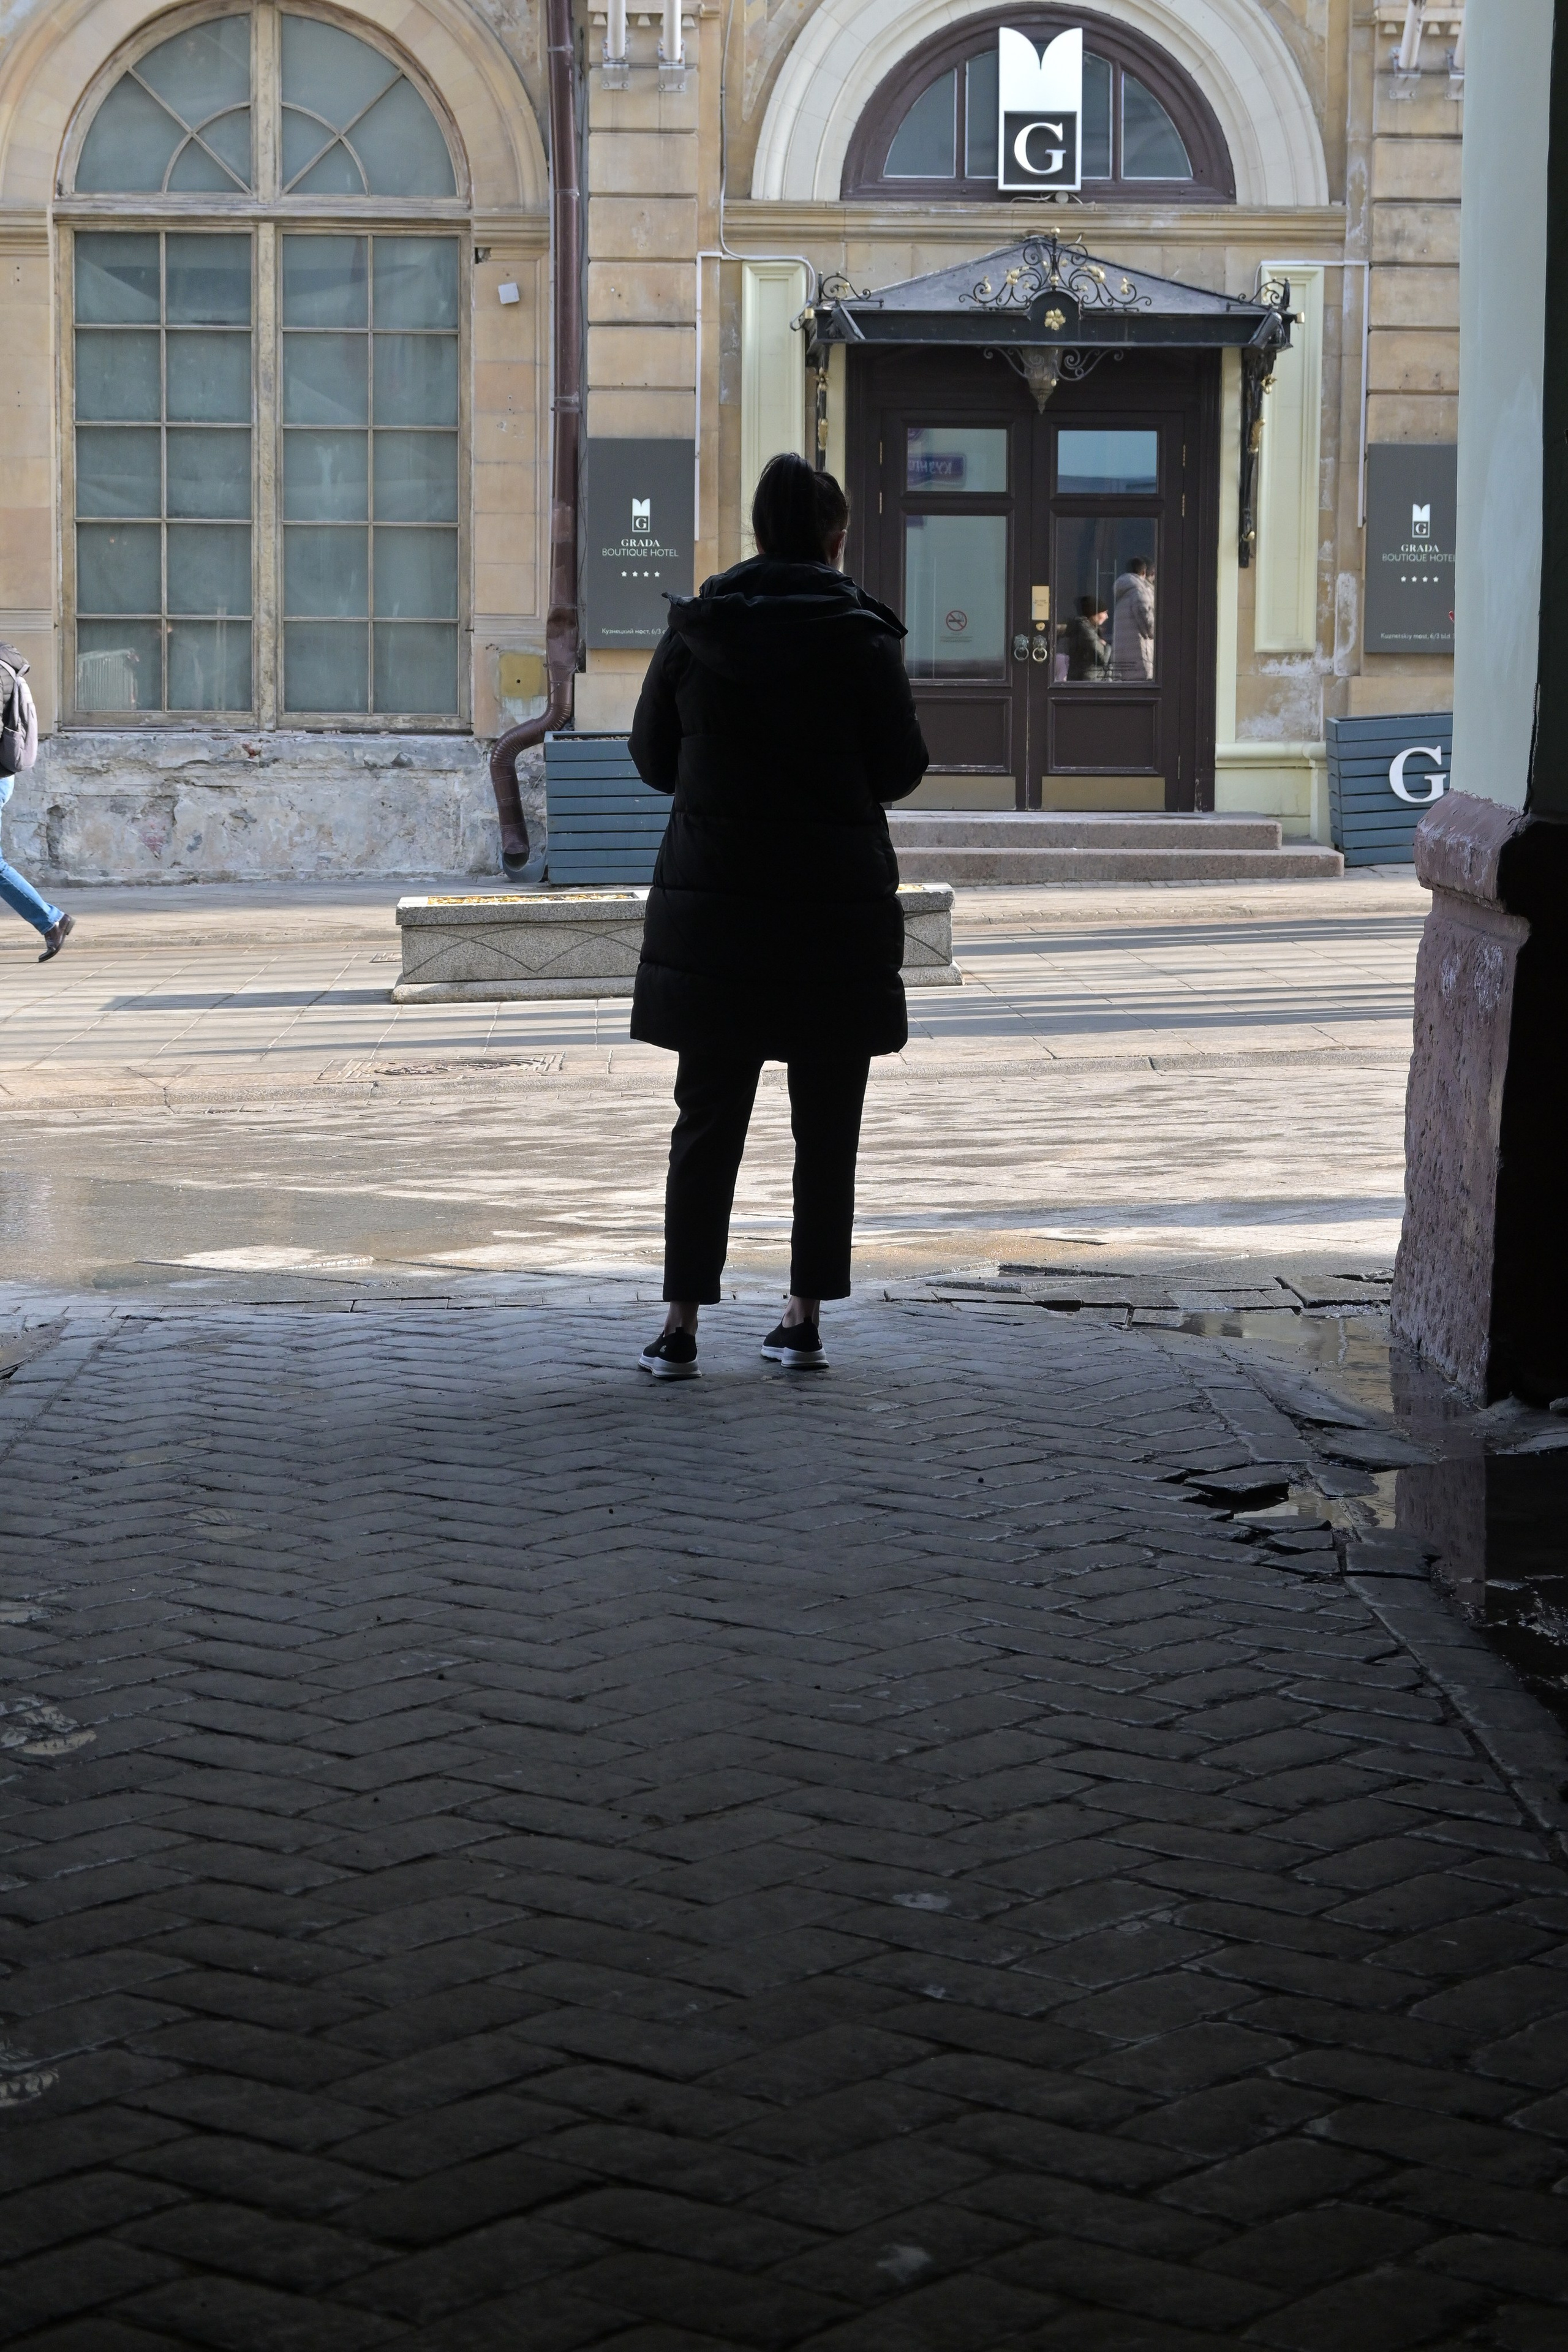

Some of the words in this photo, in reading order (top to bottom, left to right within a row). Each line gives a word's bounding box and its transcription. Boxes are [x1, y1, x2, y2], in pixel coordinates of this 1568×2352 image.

[1014, 123, 1066, 175] G
[635, 517, 647, 529] G
[1415, 522, 1427, 535] G
[650, 548, 679, 557] HOTEL
[1401, 544, 1439, 552] GRADA
[1382, 553, 1427, 562] BOUTIQUE
[1389, 745, 1446, 803] G
